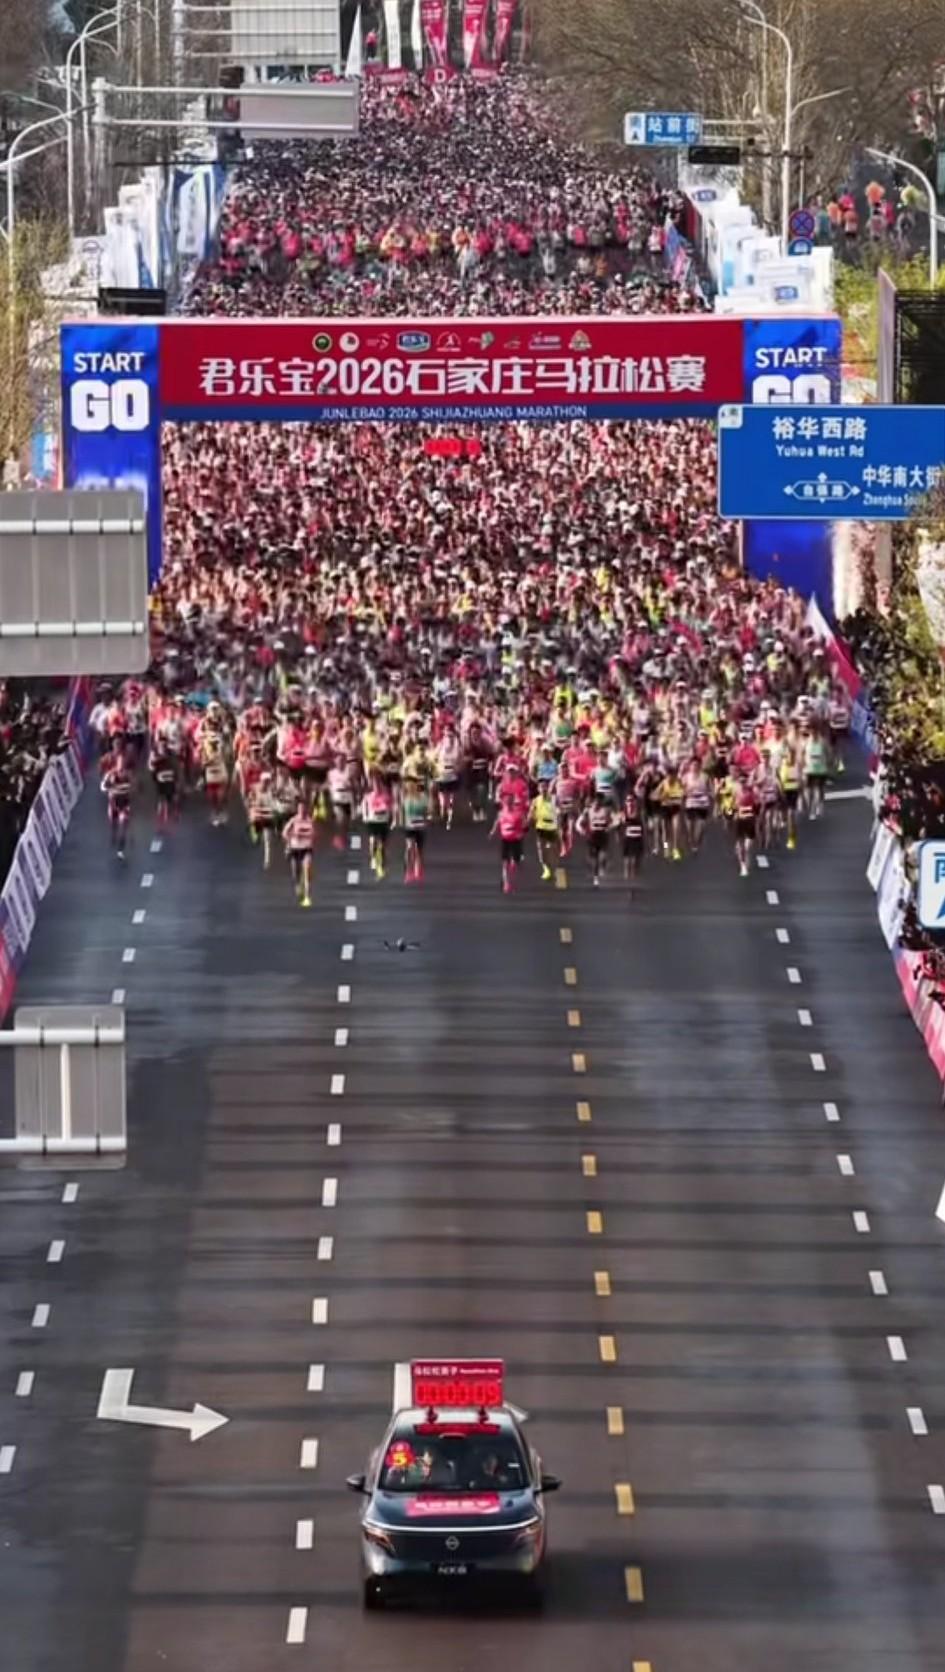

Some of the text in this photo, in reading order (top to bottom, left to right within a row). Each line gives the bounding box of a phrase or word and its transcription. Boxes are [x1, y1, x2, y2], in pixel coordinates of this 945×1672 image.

[73, 351, 145, 373] START
[755, 346, 828, 368] START
[198, 355, 707, 396] 君乐宝2026石家庄马拉松赛
[69, 379, 150, 432] GO
[320, 404, 588, 420] JUNLEBAO 2026 SHIJIAZHUANG MARATHON
[771, 415, 868, 441] 裕华西路
[775, 444, 865, 458] Yuhua West Rd
